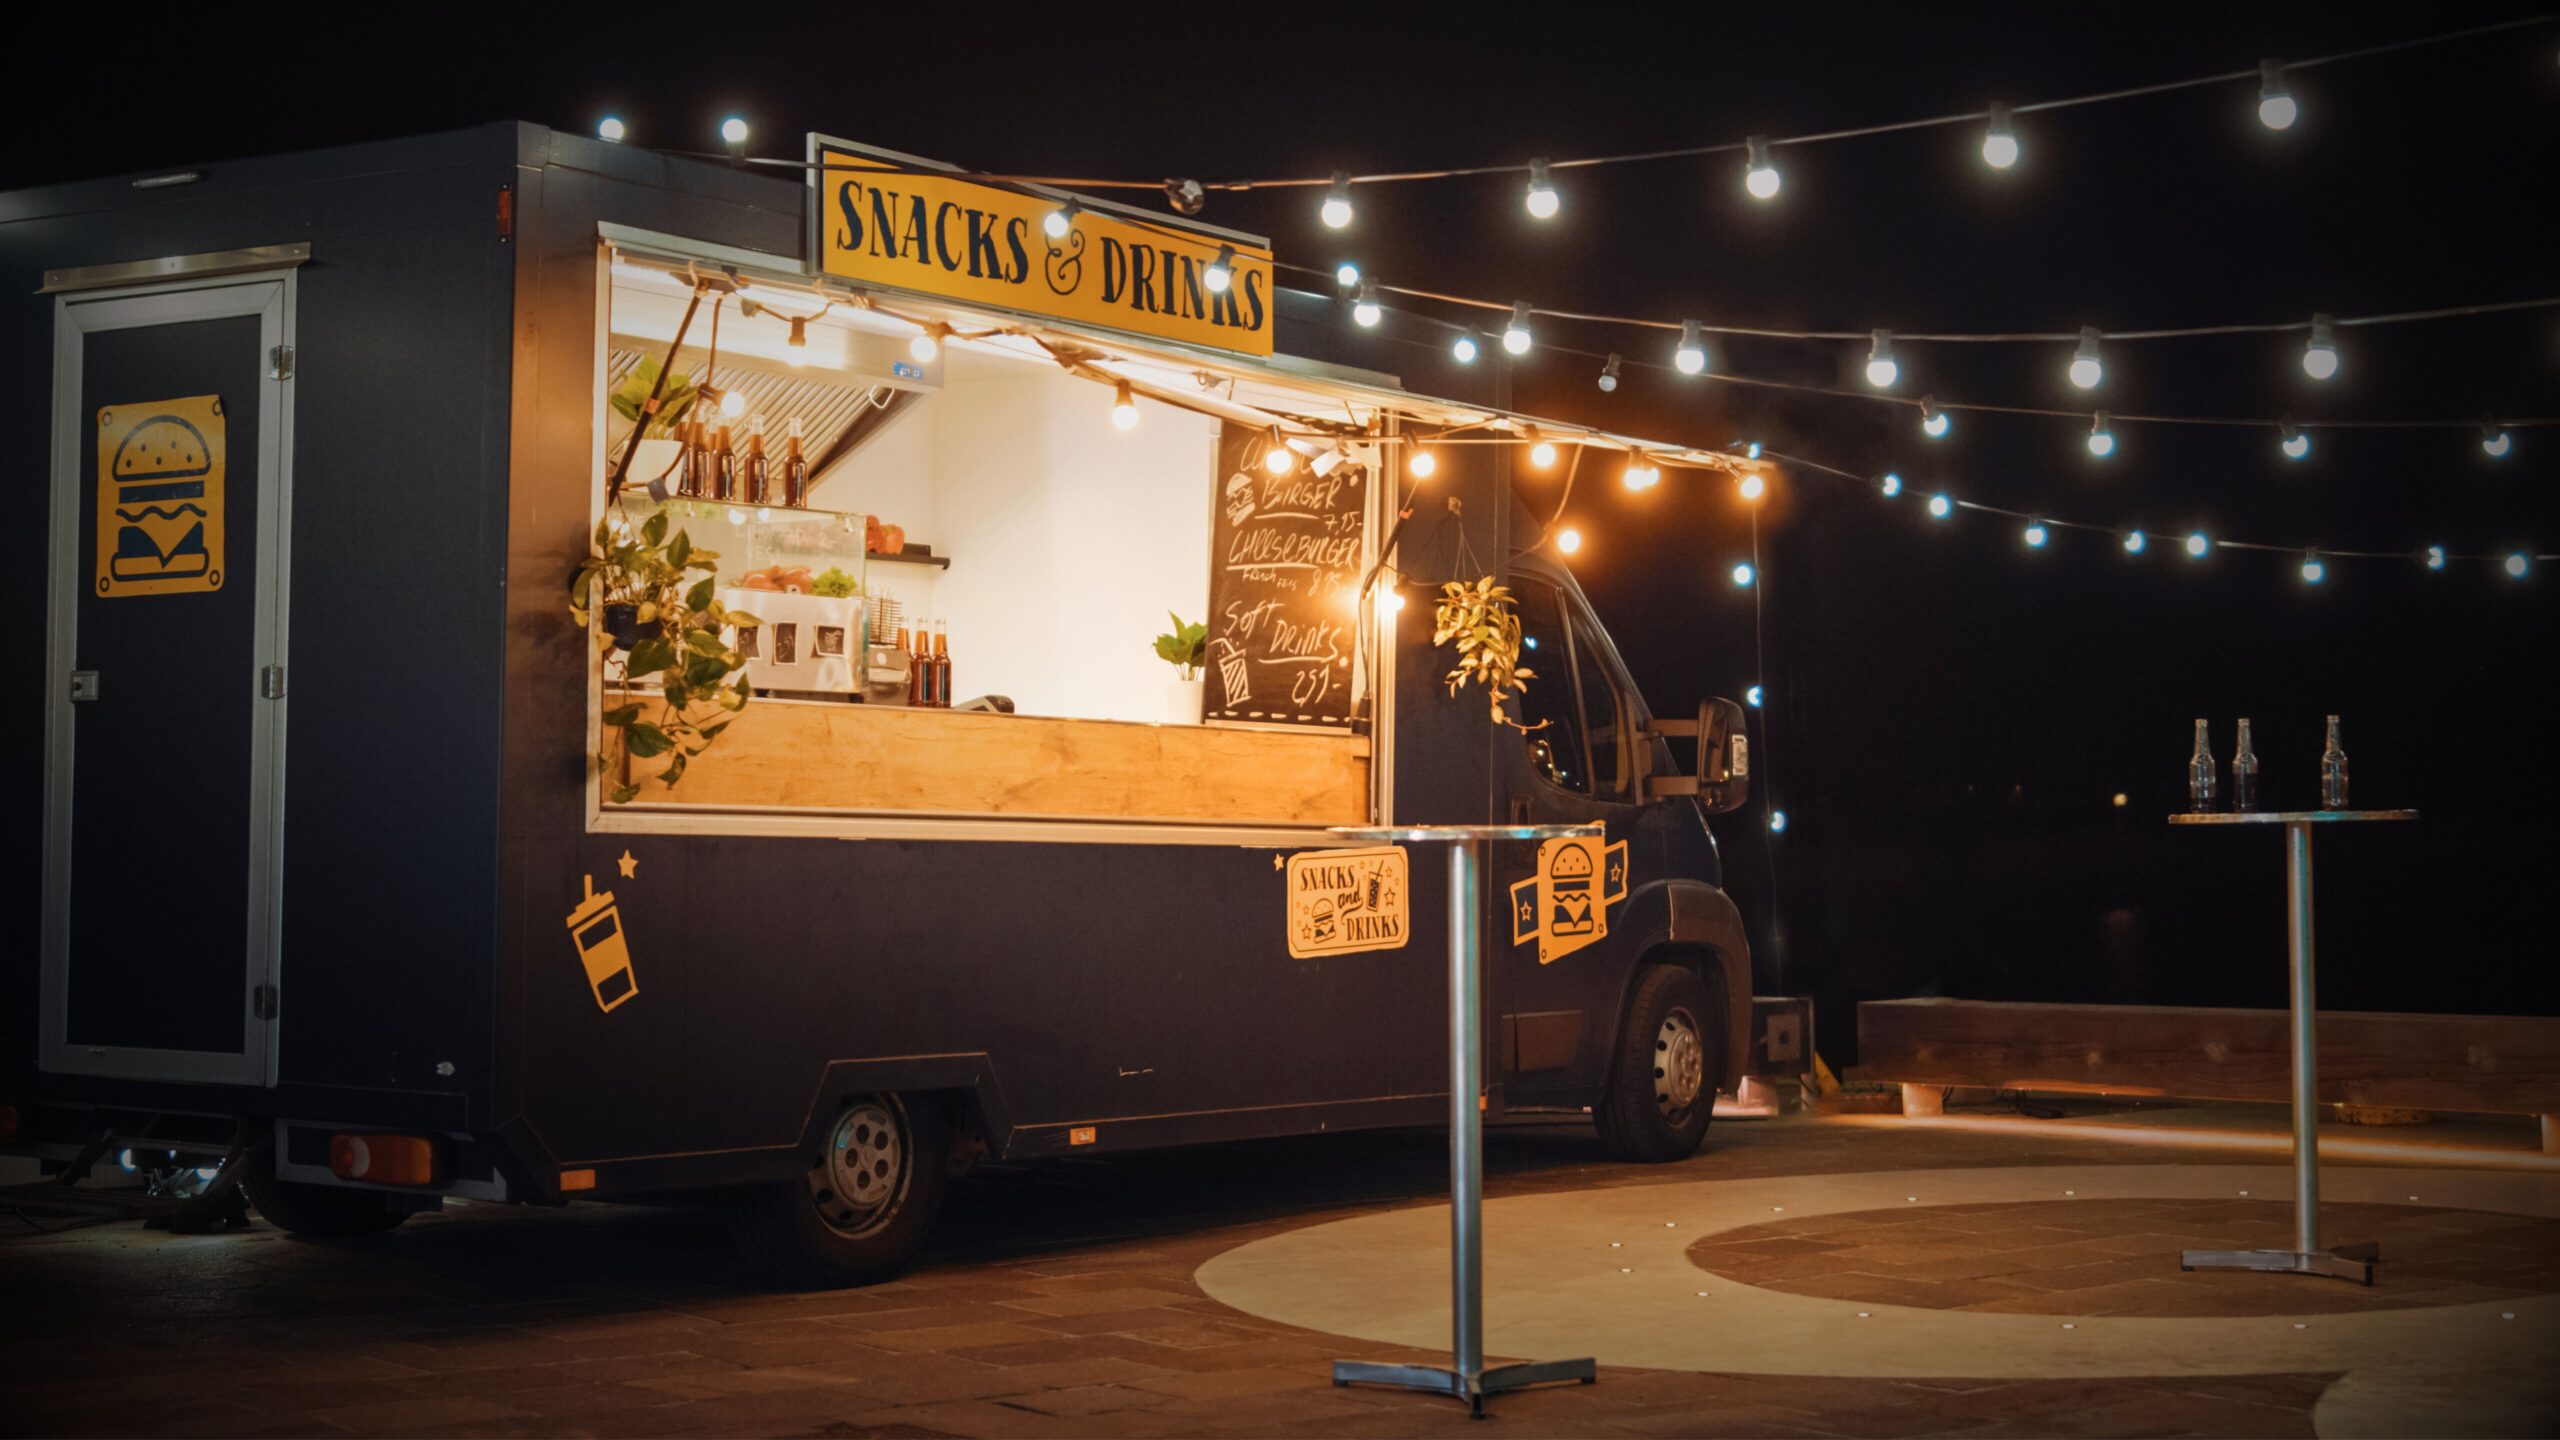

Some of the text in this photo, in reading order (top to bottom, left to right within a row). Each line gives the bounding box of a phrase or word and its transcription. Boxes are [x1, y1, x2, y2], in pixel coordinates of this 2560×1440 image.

[837, 180, 1264, 332] SNACKS & DRINKS
[1300, 864, 1355, 892] SNACKS
[1337, 878, 1364, 909] and
[1346, 914, 1399, 941] DRINKS
